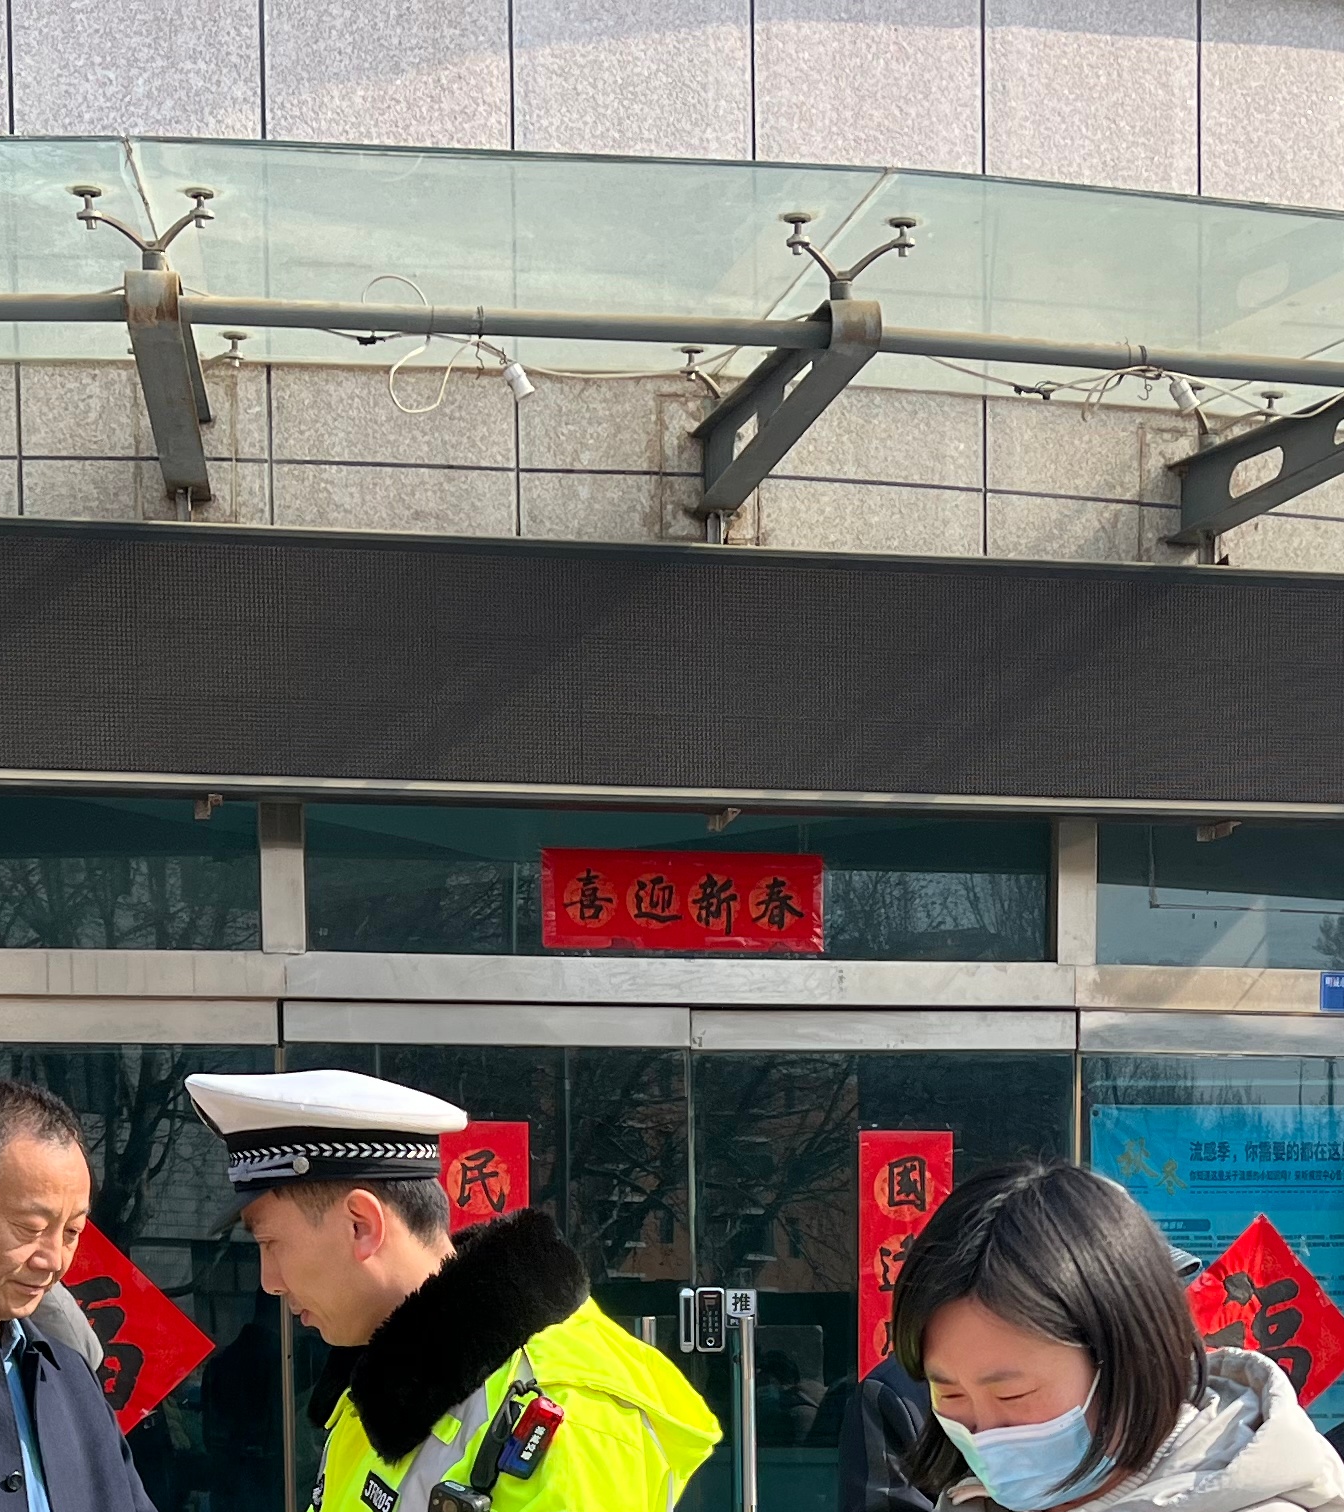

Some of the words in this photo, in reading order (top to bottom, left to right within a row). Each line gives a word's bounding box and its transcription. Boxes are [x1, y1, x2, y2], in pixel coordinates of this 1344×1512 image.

[563, 867, 805, 936] 喜迎新春
[732, 1292, 752, 1312] 推
